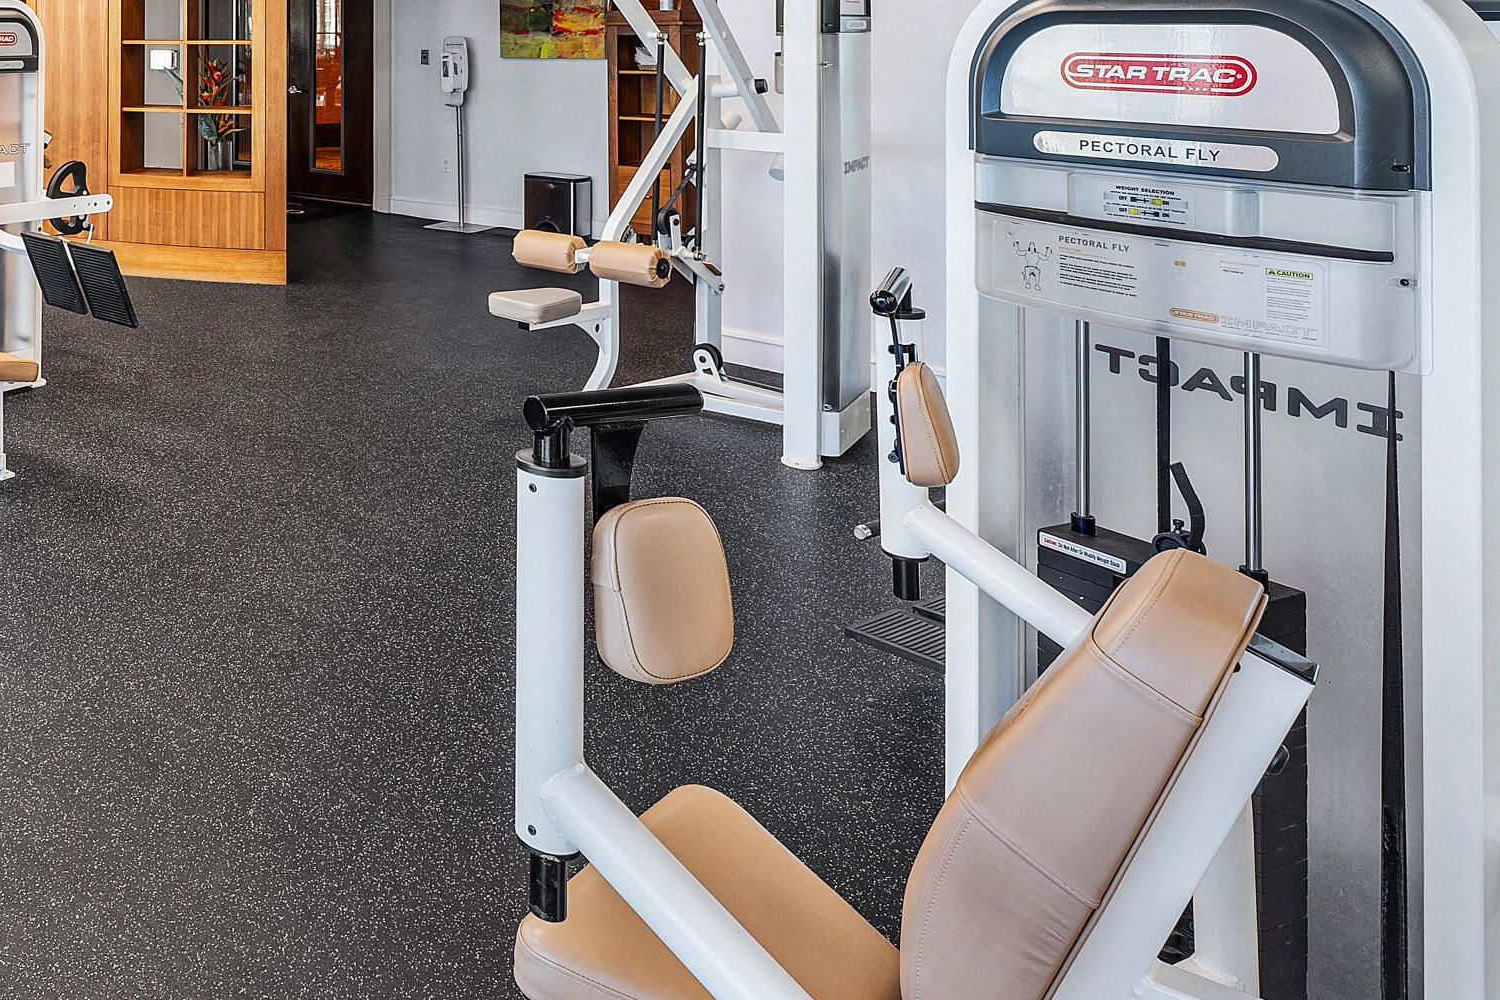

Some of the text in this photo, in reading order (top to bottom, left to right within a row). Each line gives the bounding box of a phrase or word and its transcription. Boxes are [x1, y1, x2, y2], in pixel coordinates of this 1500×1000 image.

[1071, 64, 1236, 83] STAR TRAC
[1079, 139, 1221, 162] PECTORAL FLY
[1141, 187, 1175, 196] SELECTION
[1058, 235, 1109, 250] PECTORAL
[1112, 243, 1130, 252] FLY
[1276, 270, 1311, 279] CAUTION
